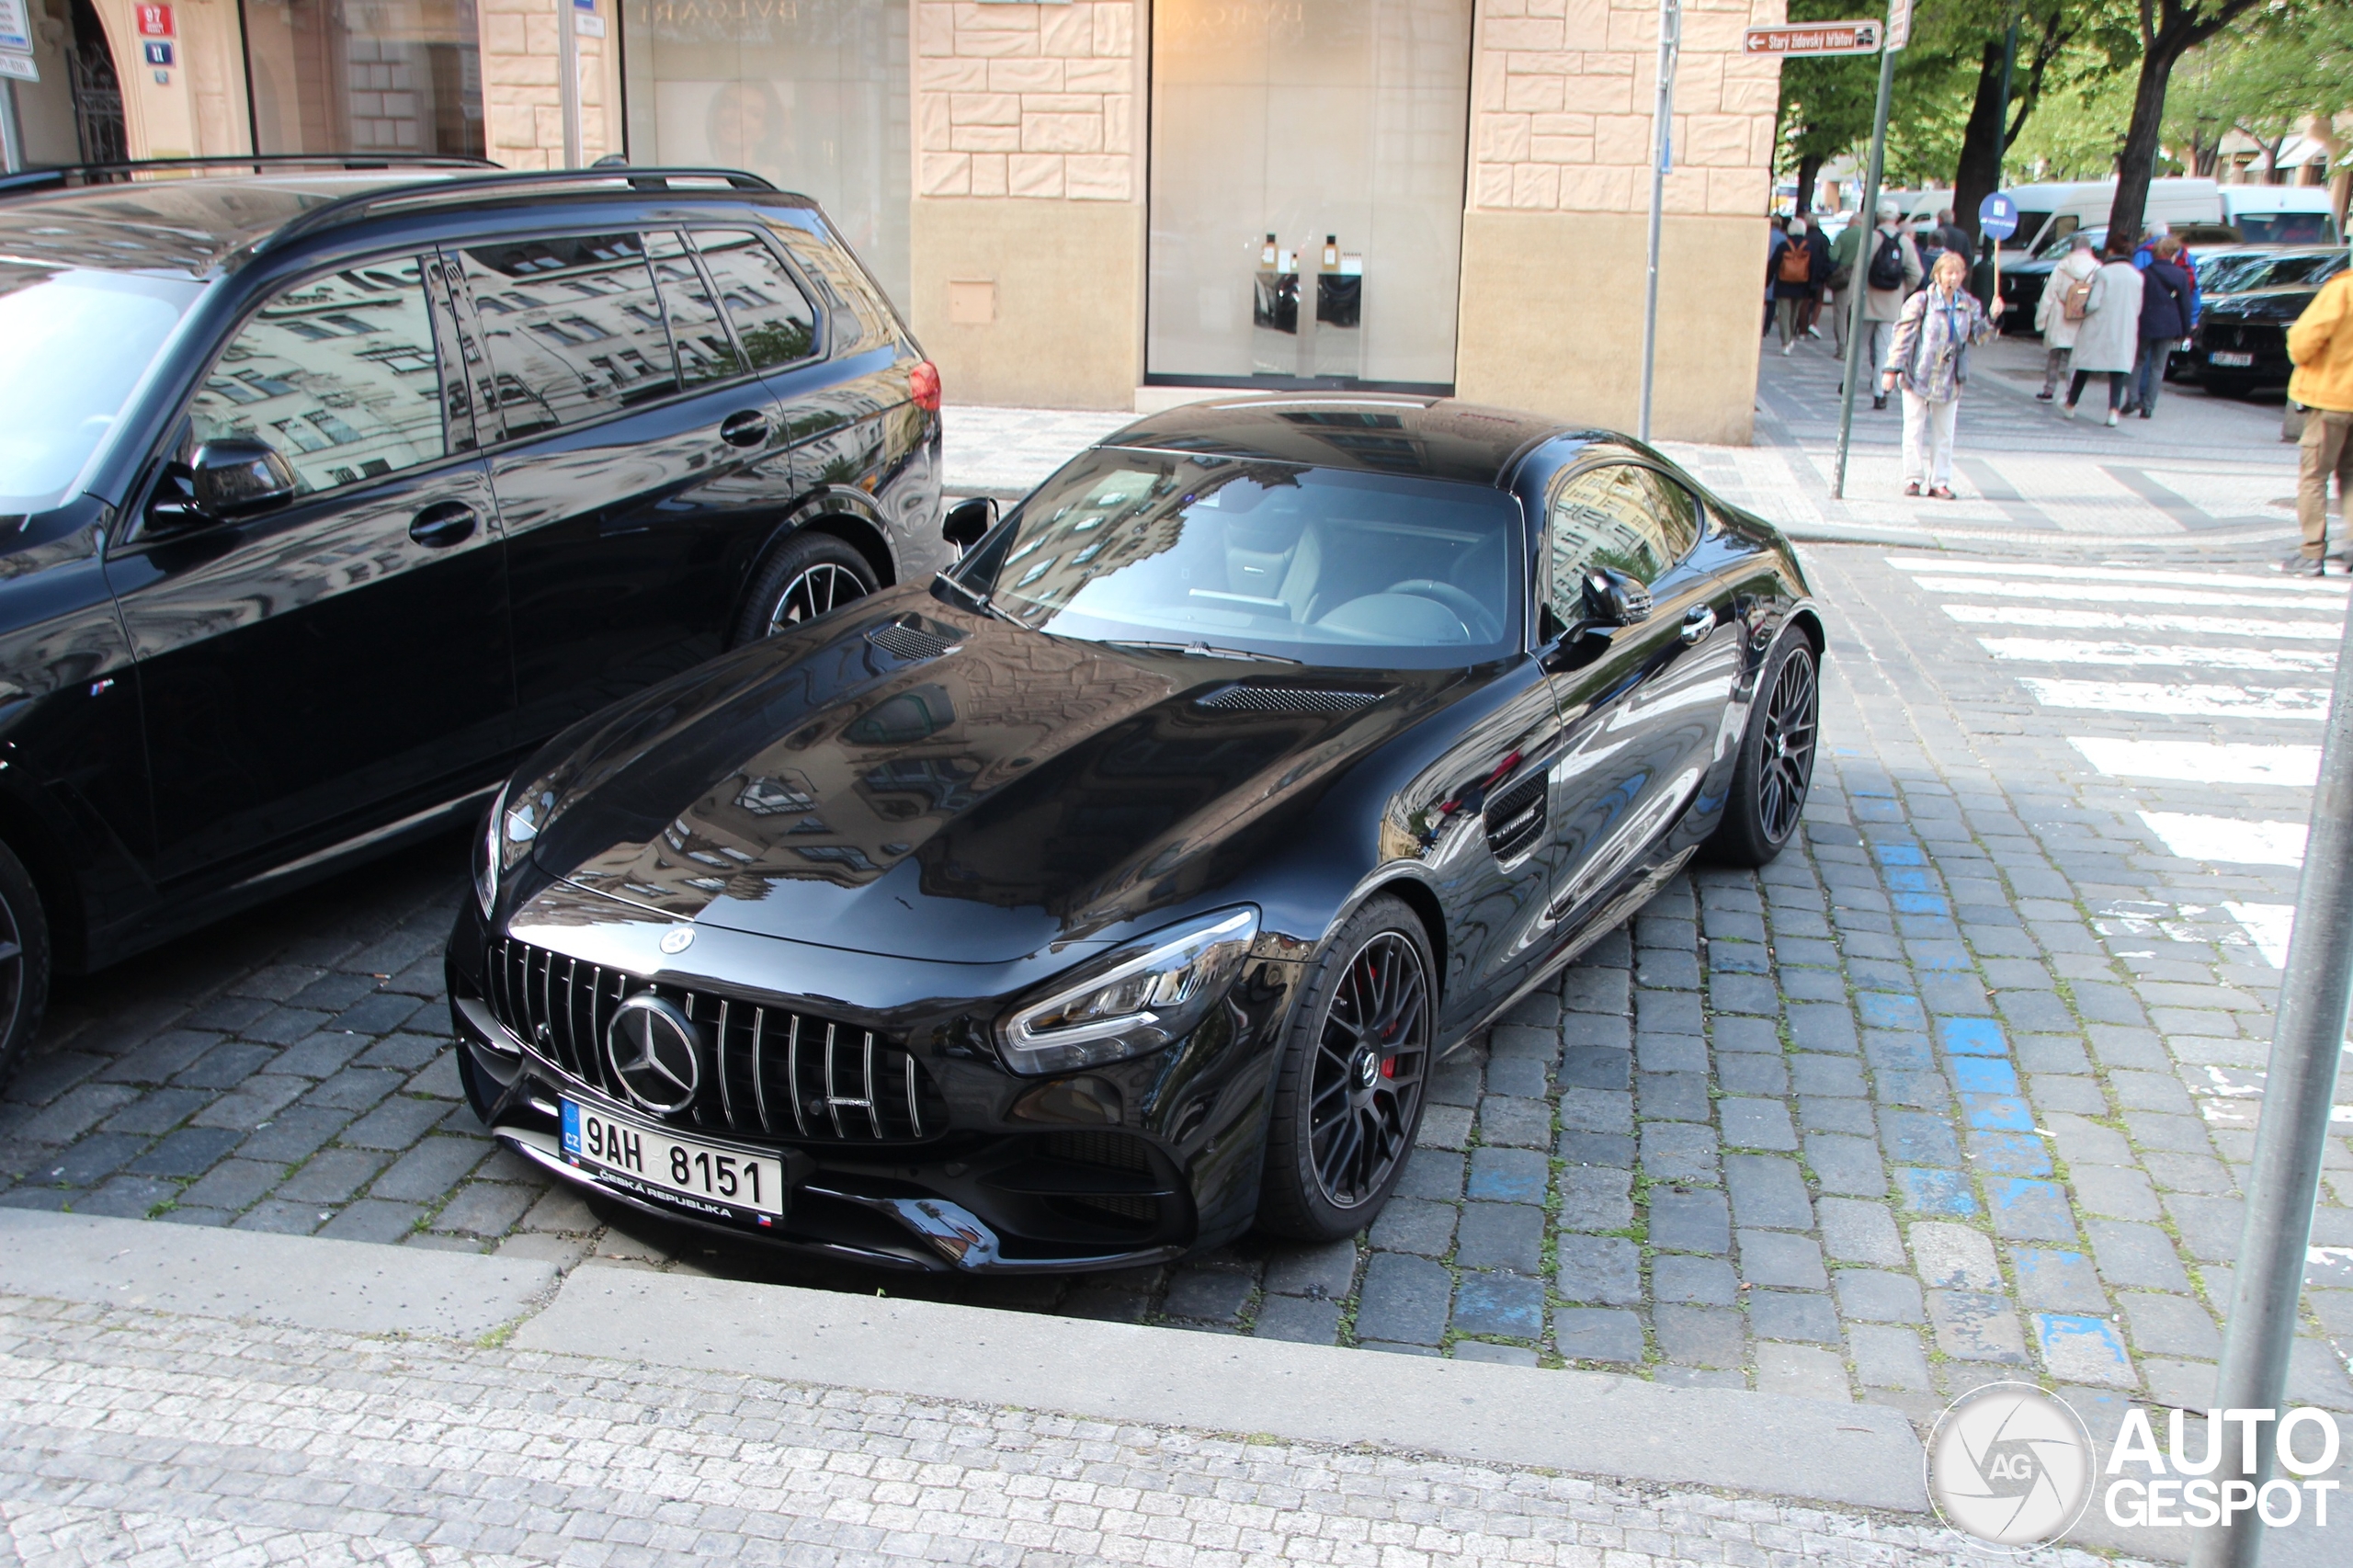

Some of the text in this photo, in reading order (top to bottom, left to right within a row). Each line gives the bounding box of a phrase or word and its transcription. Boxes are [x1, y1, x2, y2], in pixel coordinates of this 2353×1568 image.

[145, 7, 161, 23] 97
[1768, 30, 1854, 51] Starý židovský hřbitov
[151, 44, 164, 62] 11
[565, 1131, 580, 1149] CZ
[586, 1117, 760, 1204] 9AH 8151
[599, 1168, 733, 1219] ČESKÁ REPUBLIKA
